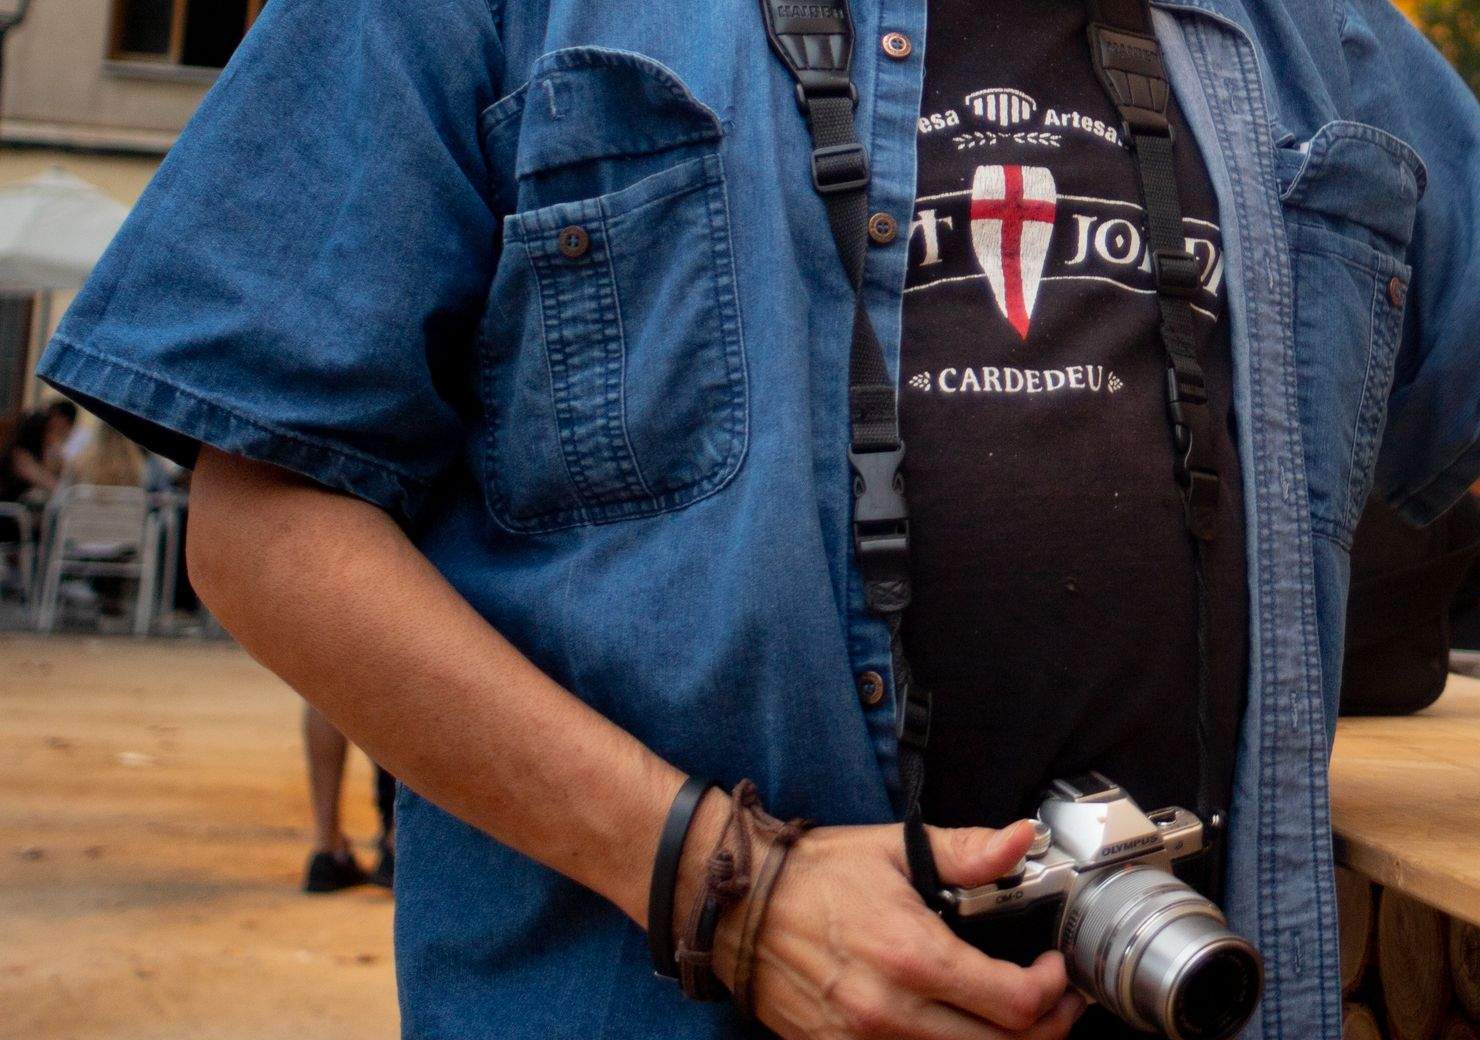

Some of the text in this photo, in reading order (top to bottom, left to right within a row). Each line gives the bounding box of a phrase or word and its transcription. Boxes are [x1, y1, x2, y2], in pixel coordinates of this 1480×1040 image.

[1044, 108, 1125, 148] Artesa
[938, 364, 1103, 394] CARDEDEU
[1102, 833, 1159, 857] OLYMPUS
